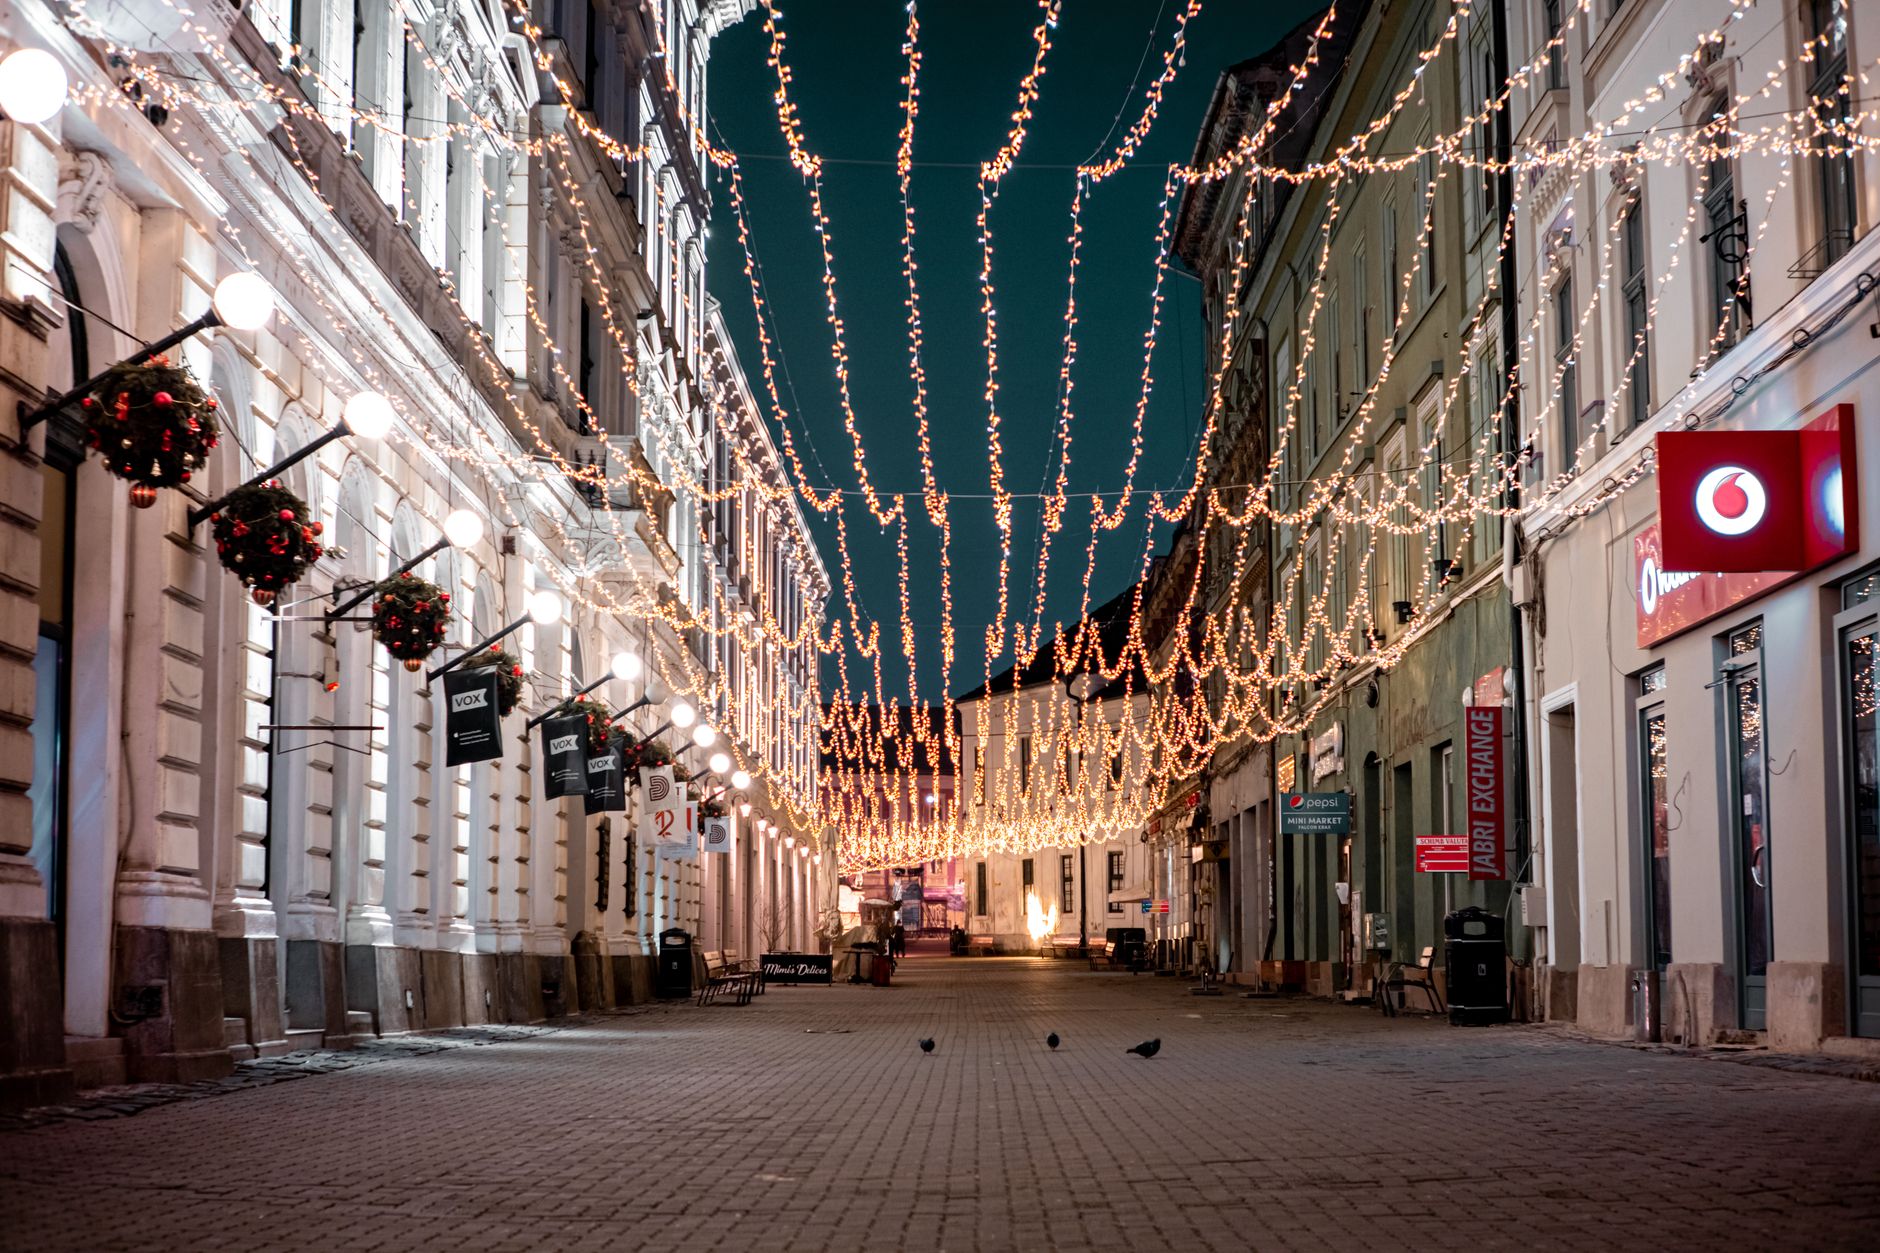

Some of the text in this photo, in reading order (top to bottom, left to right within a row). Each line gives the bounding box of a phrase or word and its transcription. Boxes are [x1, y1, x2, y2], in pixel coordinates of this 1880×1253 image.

[455, 694, 481, 707] VOX
[552, 738, 573, 750] VOX
[590, 759, 610, 769] VOX
[1471, 710, 1495, 813] EXCHANGE
[1307, 797, 1338, 808] pepsi
[1287, 817, 1342, 825] MINI MARKET
[1472, 820, 1501, 877] JABRI
[764, 963, 827, 976] Mimi's Delices
